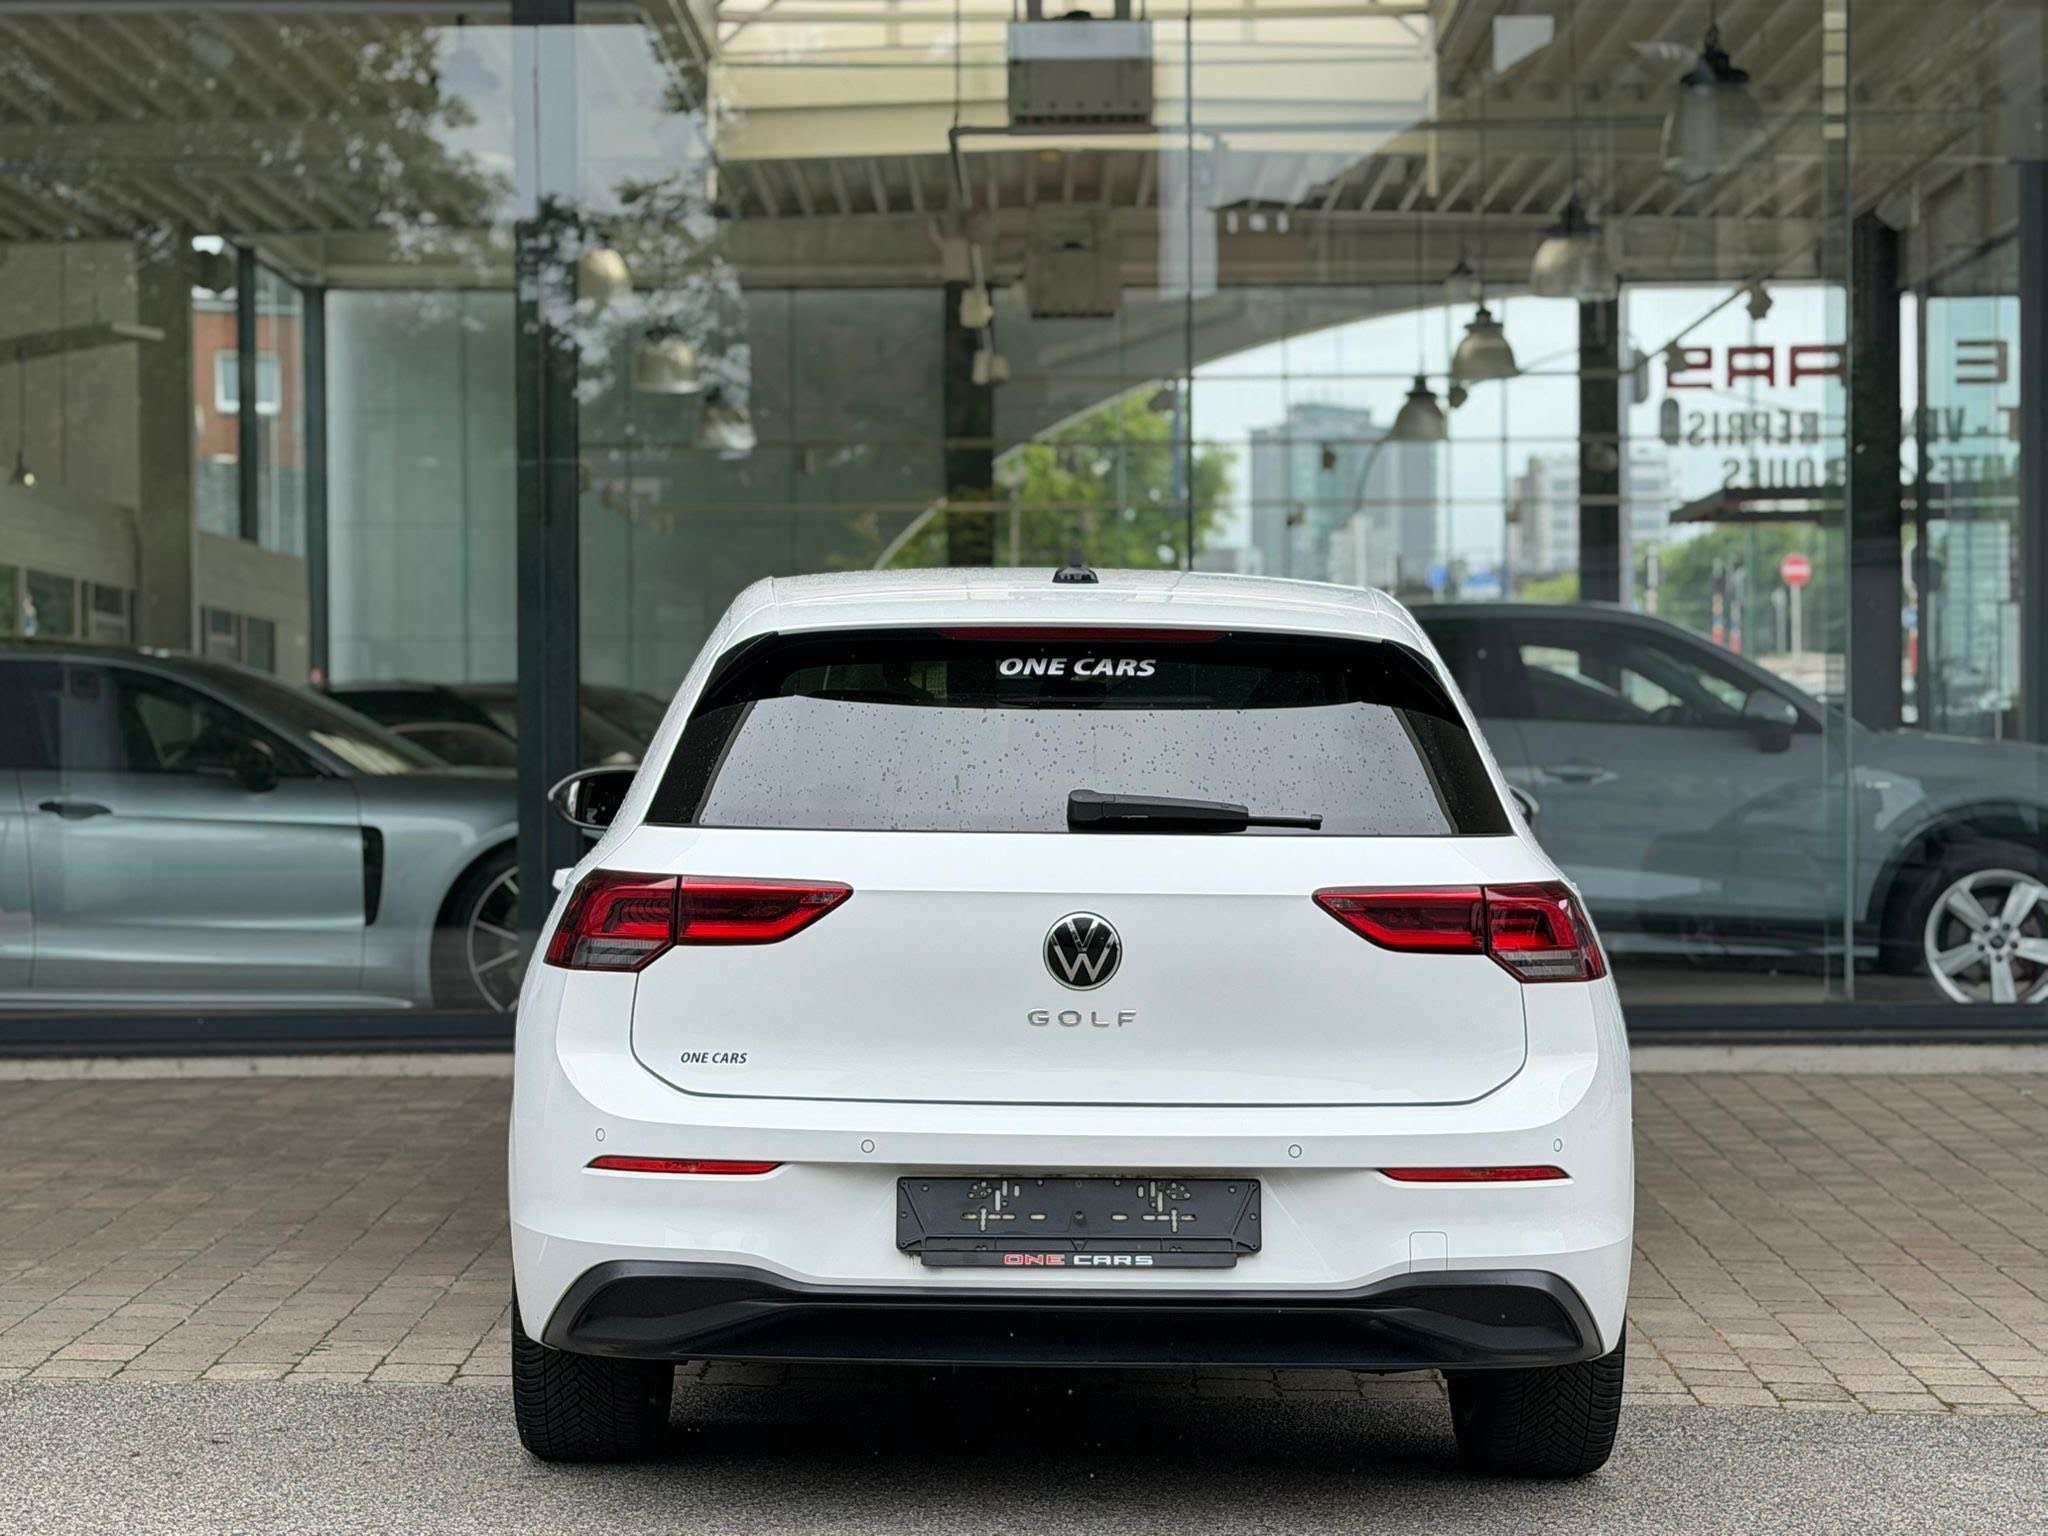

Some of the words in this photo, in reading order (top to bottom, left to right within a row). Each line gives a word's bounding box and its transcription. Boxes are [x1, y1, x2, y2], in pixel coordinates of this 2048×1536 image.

[1000, 658, 1067, 675] ONE
[1073, 658, 1157, 676] CARS
[1027, 1008, 1137, 1027] GOLF
[680, 1052, 709, 1064] ONE
[712, 1052, 747, 1064] CARS
[1004, 1254, 1065, 1265] ONE
[1073, 1254, 1154, 1266] CARS
